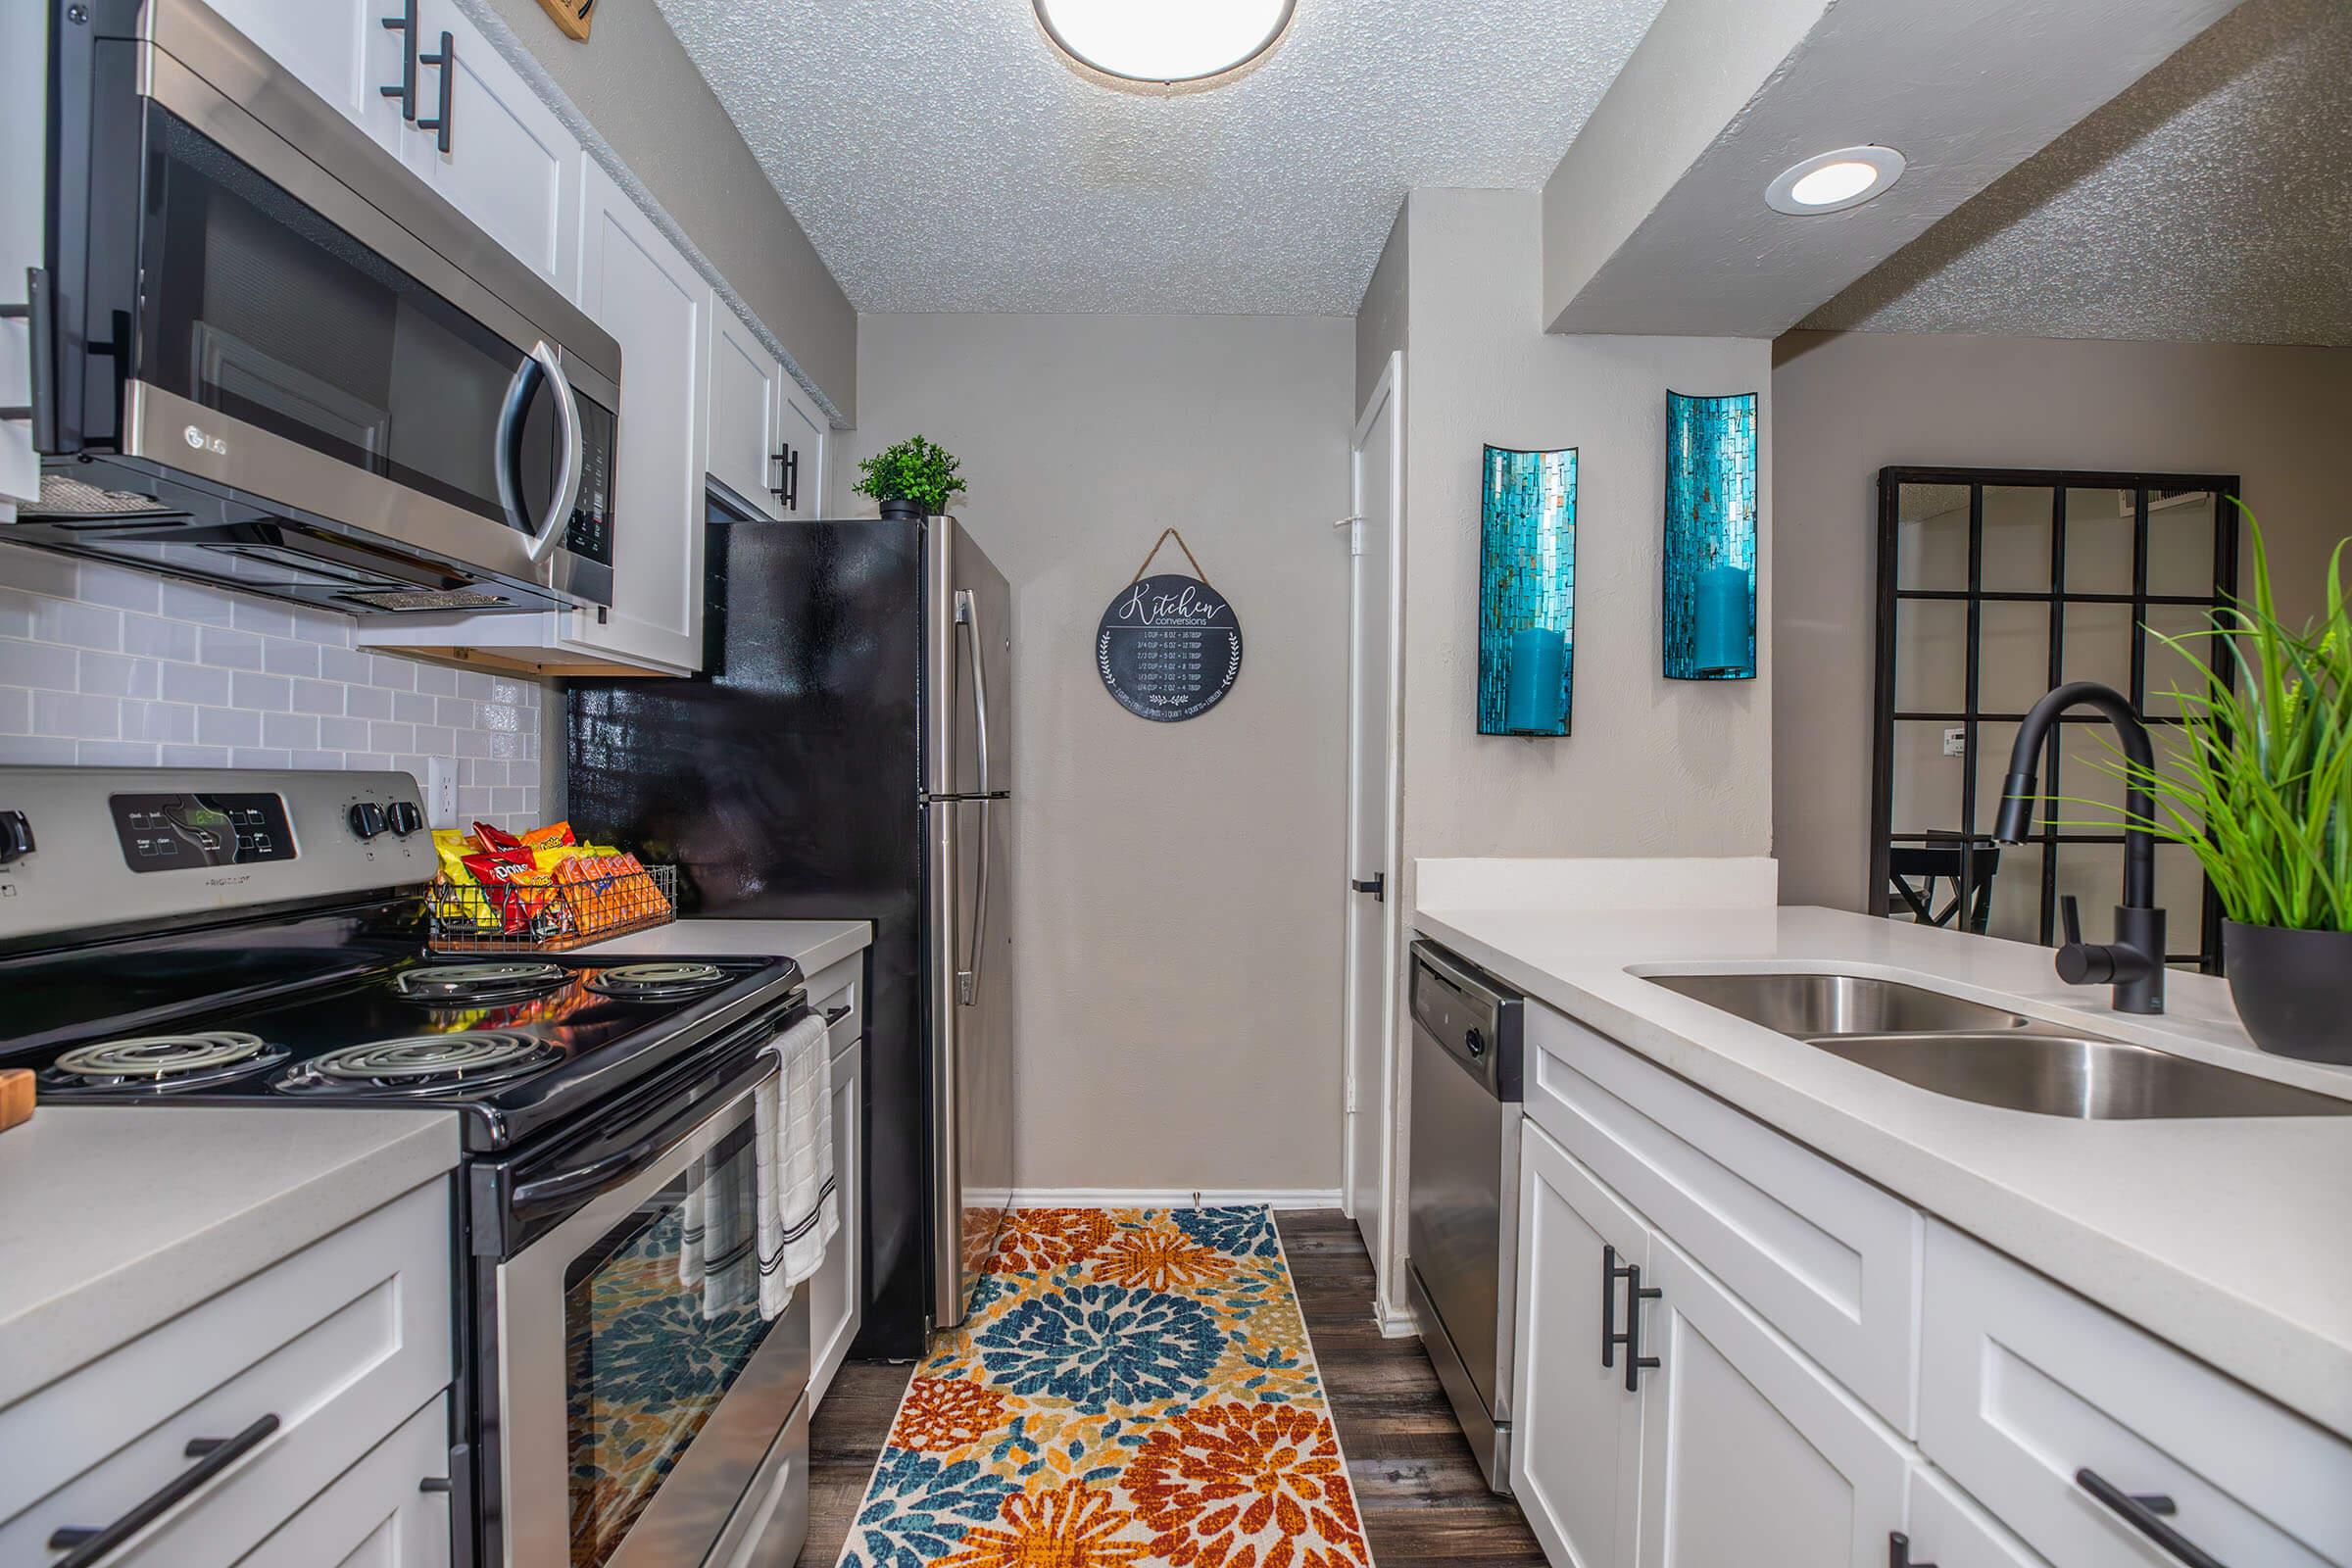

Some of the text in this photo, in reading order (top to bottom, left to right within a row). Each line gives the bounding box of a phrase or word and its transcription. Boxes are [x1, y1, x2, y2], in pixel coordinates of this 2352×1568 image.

[205, 434, 226, 456] LG
[1118, 583, 1226, 625] Kitchen
[1155, 617, 1207, 626] conversions
